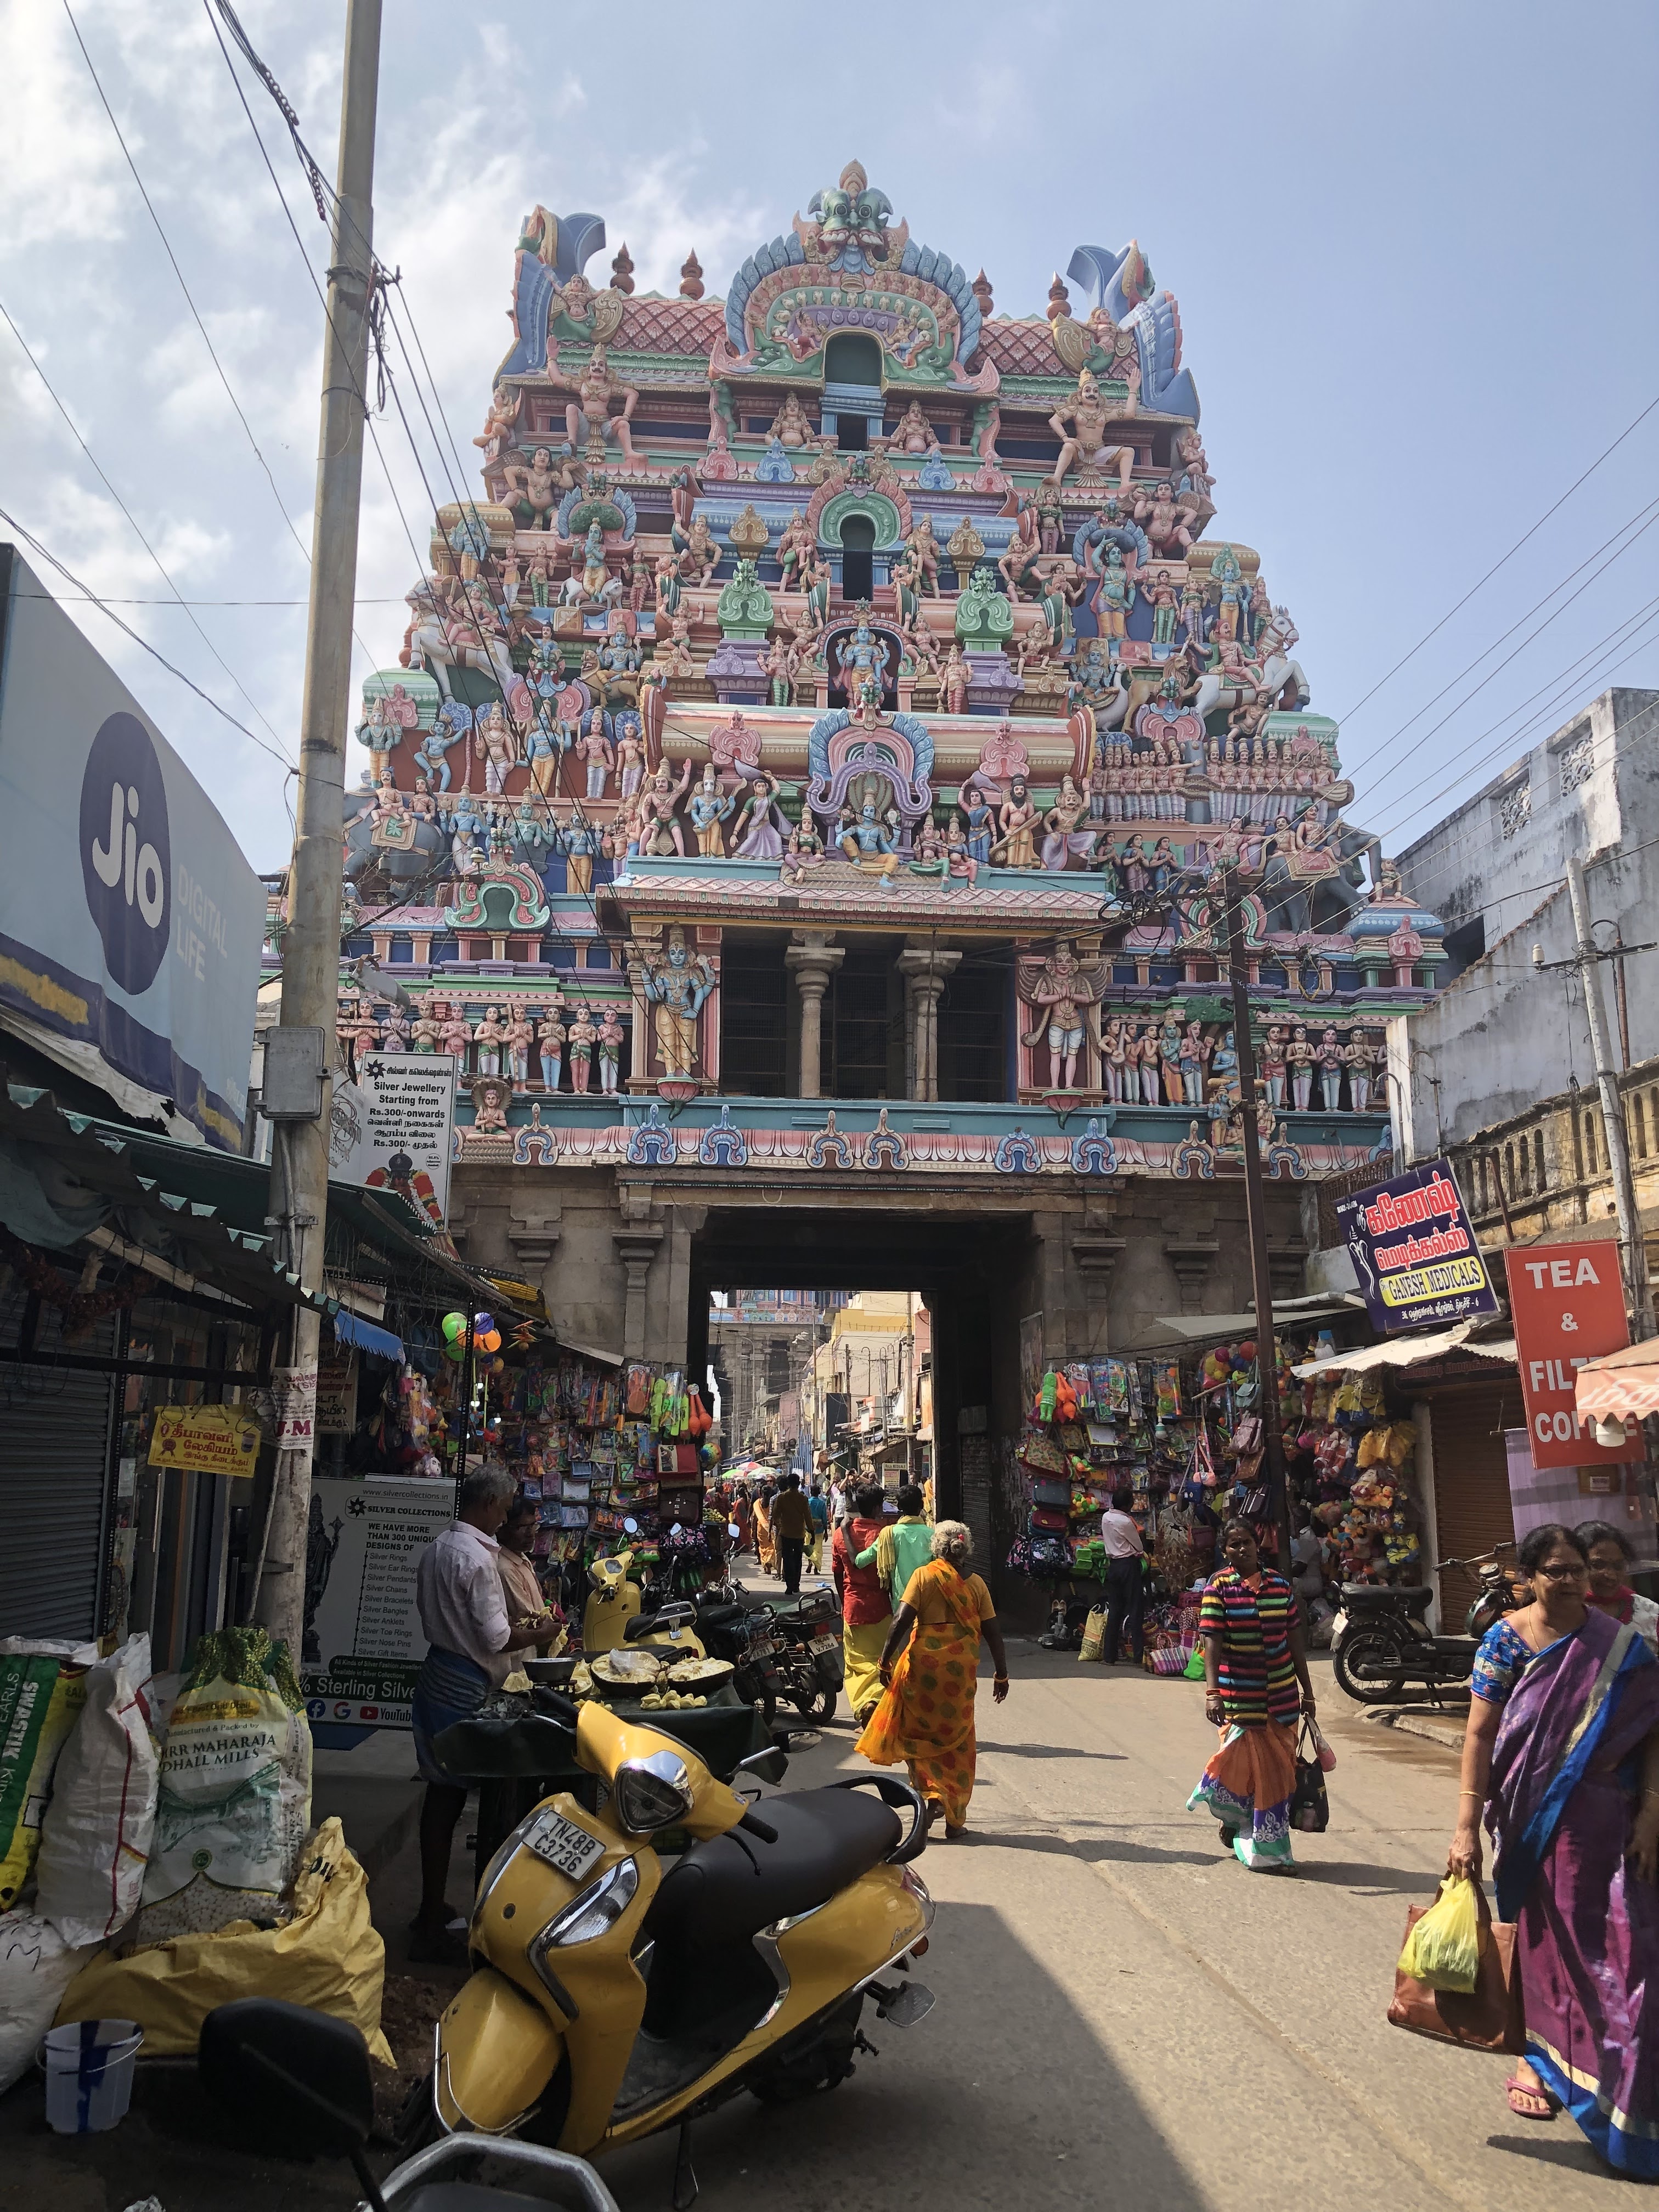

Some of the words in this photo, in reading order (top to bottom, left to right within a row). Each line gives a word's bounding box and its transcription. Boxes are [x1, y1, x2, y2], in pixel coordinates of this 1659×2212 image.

[92, 782, 164, 928] Jio
[178, 863, 228, 959] DIGITAL
[176, 915, 206, 981] LIFE
[374, 1081, 400, 1091] Silver
[402, 1082, 446, 1095] Jewellery
[379, 1094, 415, 1107] Starting
[418, 1096, 439, 1105] from
[367, 1118, 403, 1126] வெள்ளி
[404, 1120, 444, 1128] நகைகள்
[374, 1128, 407, 1138] ஆரம்ப
[408, 1130, 436, 1138] விலை
[373, 1139, 410, 1148] Rs.300/-
[412, 1141, 438, 1150] முதல்
[1374, 1222, 1470, 1272] மெடிக்கல்ஸ்
[1389, 1273, 1428, 1300] GANESH
[1425, 1260, 1481, 1293] MEDICALS
[1525, 1258, 1600, 1289] TEA
[1561, 1312, 1579, 1331] &
[1529, 1356, 1604, 1392] FILT
[171, 1423, 234, 1444] தீபாவளி
[363, 1489, 448, 1500] www.silvercollections.in
[367, 1505, 396, 1514] SILVER
[397, 1508, 451, 1517] COLLECTIONS
[382, 1523, 405, 1532] HAVE
[407, 1525, 430, 1533] MORE
[367, 1532, 390, 1541] THAN
[366, 1541, 401, 1551] DESIGNS
[389, 1554, 408, 1562] Rings
[386, 1575, 416, 1583] Pendants
[383, 1596, 414, 1605] Bracelets
[382, 1606, 409, 1616] Bangles
[362, 1616, 380, 1624] Silver
[381, 1617, 405, 1626] Anklets
[394, 1629, 413, 1638] Rings
[359, 1637, 378, 1645] Silver
[377, 1671, 405, 1679] Collections
[317, 1677, 376, 1700] Sterling
[381, 1681, 415, 1699] Silve
[3, 1681, 39, 1760] SWASTIK
[380, 1707, 412, 1722] YouTub
[221, 1723, 247, 1731] Packed
[192, 1733, 276, 1754] MAHARAJA
[162, 1754, 210, 1773] DHALL
[214, 1747, 259, 1765] MILLS
[549, 1817, 596, 1857] TN48B
[534, 1834, 583, 1872] C3736
